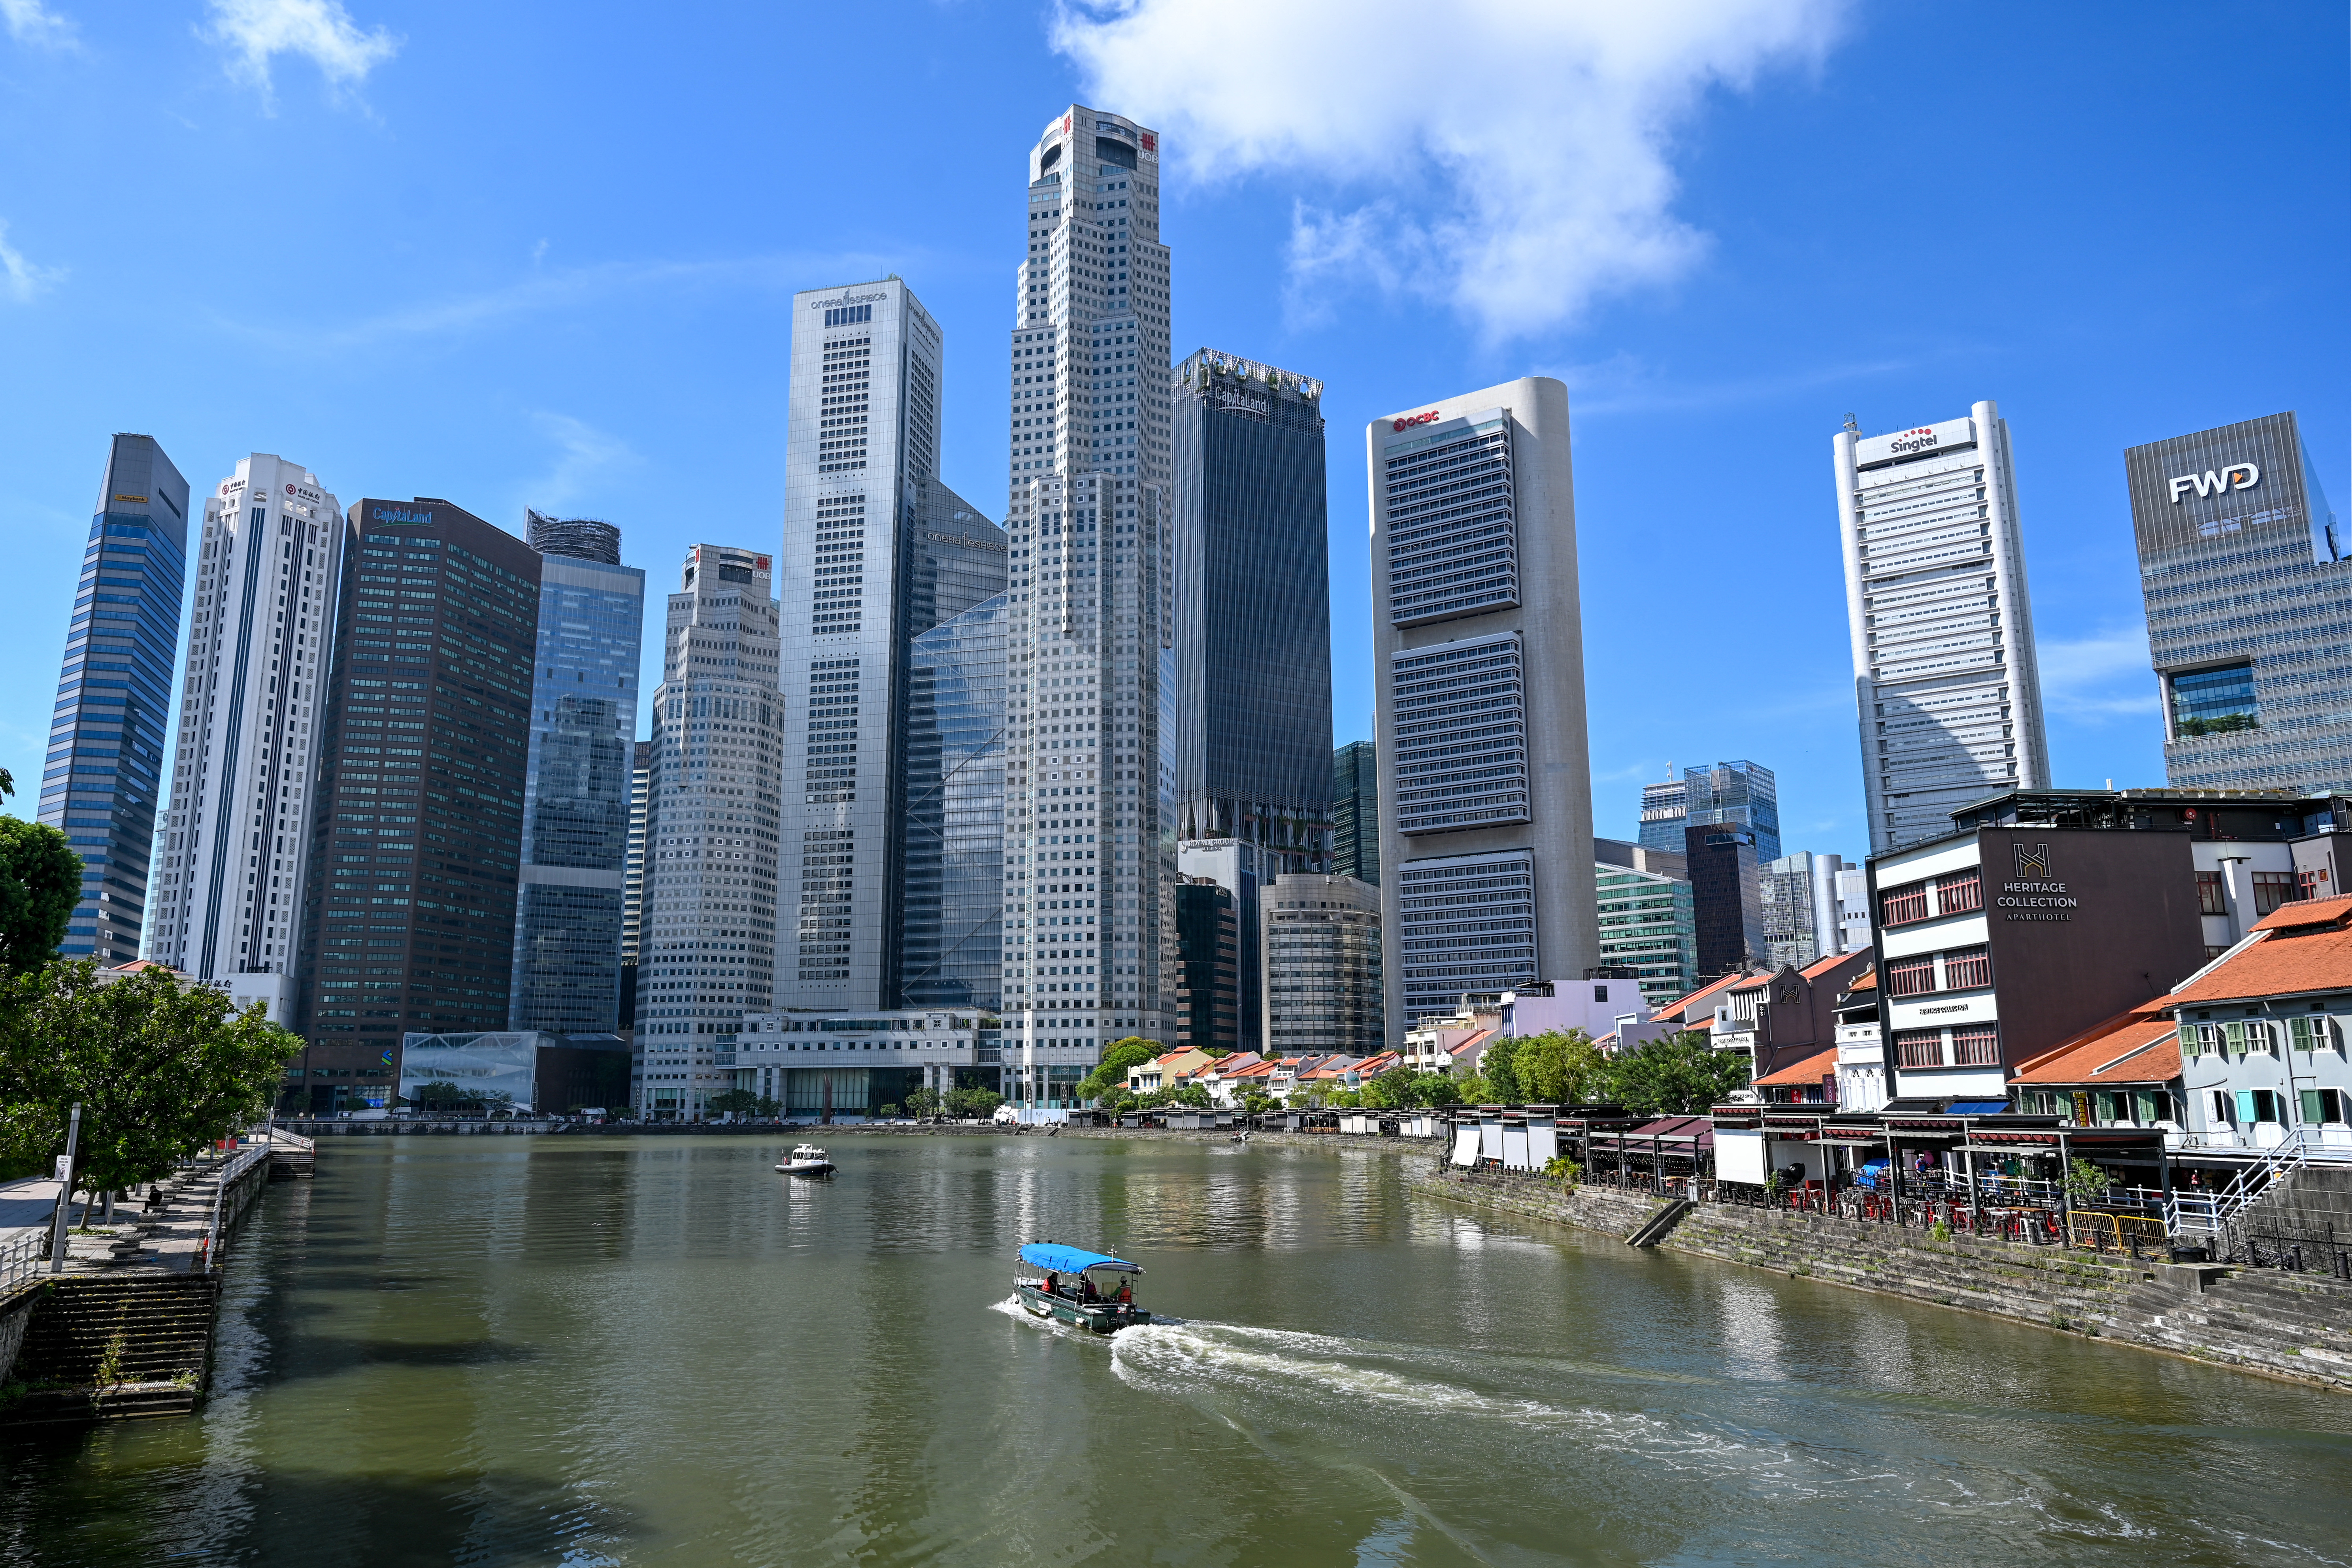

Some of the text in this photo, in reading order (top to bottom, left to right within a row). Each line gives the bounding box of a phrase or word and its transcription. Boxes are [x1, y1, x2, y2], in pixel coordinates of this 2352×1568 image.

[1061, 132, 1073, 150] UOB
[1137, 149, 1158, 164] UOB
[1215, 386, 1266, 412] CapitaLand
[1407, 410, 1440, 427] OCBC
[1891, 434, 1937, 453] Singtel
[2169, 462, 2260, 504] FWD
[298, 487, 320, 500] 中国银行
[373, 507, 432, 524] CapitaLand
[753, 570, 771, 580] UOB
[2004, 882, 2066, 892] HERITAGE
[1997, 897, 2077, 908] COLLECTION
[1920, 1004, 1968, 1015] HERITAGE COLLECTION
